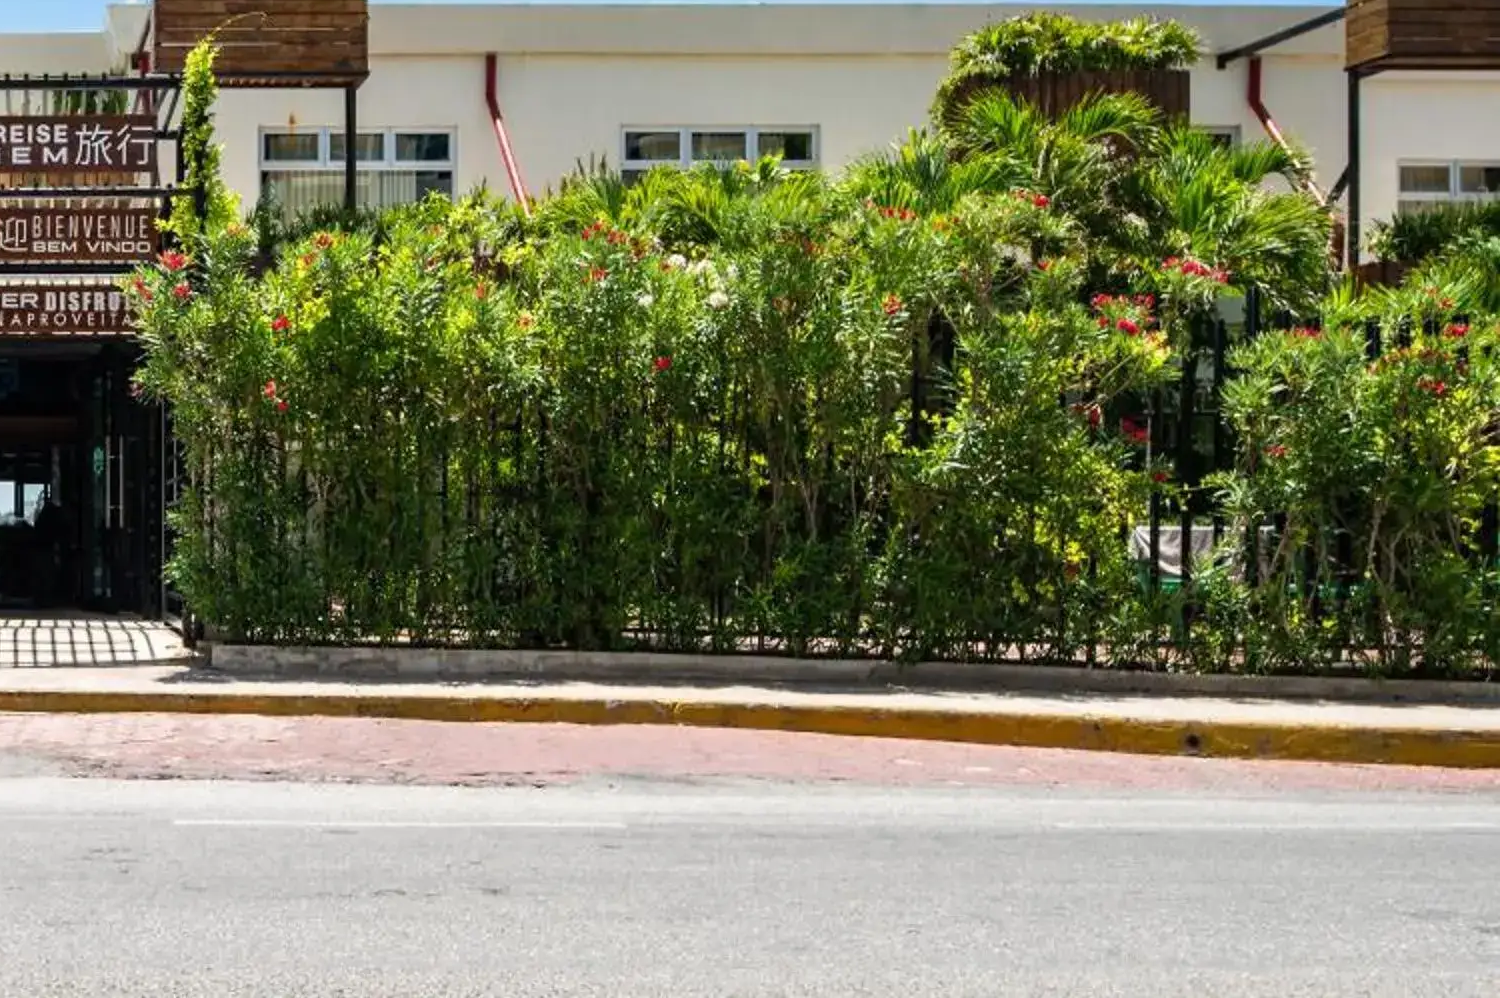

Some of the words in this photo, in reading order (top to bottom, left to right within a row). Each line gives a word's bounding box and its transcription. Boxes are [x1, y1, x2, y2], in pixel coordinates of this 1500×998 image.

[75, 123, 155, 166] 旅行
[32, 215, 149, 239] BIENVENUE
[32, 240, 78, 253] BEM
[86, 240, 151, 253] VINDO
